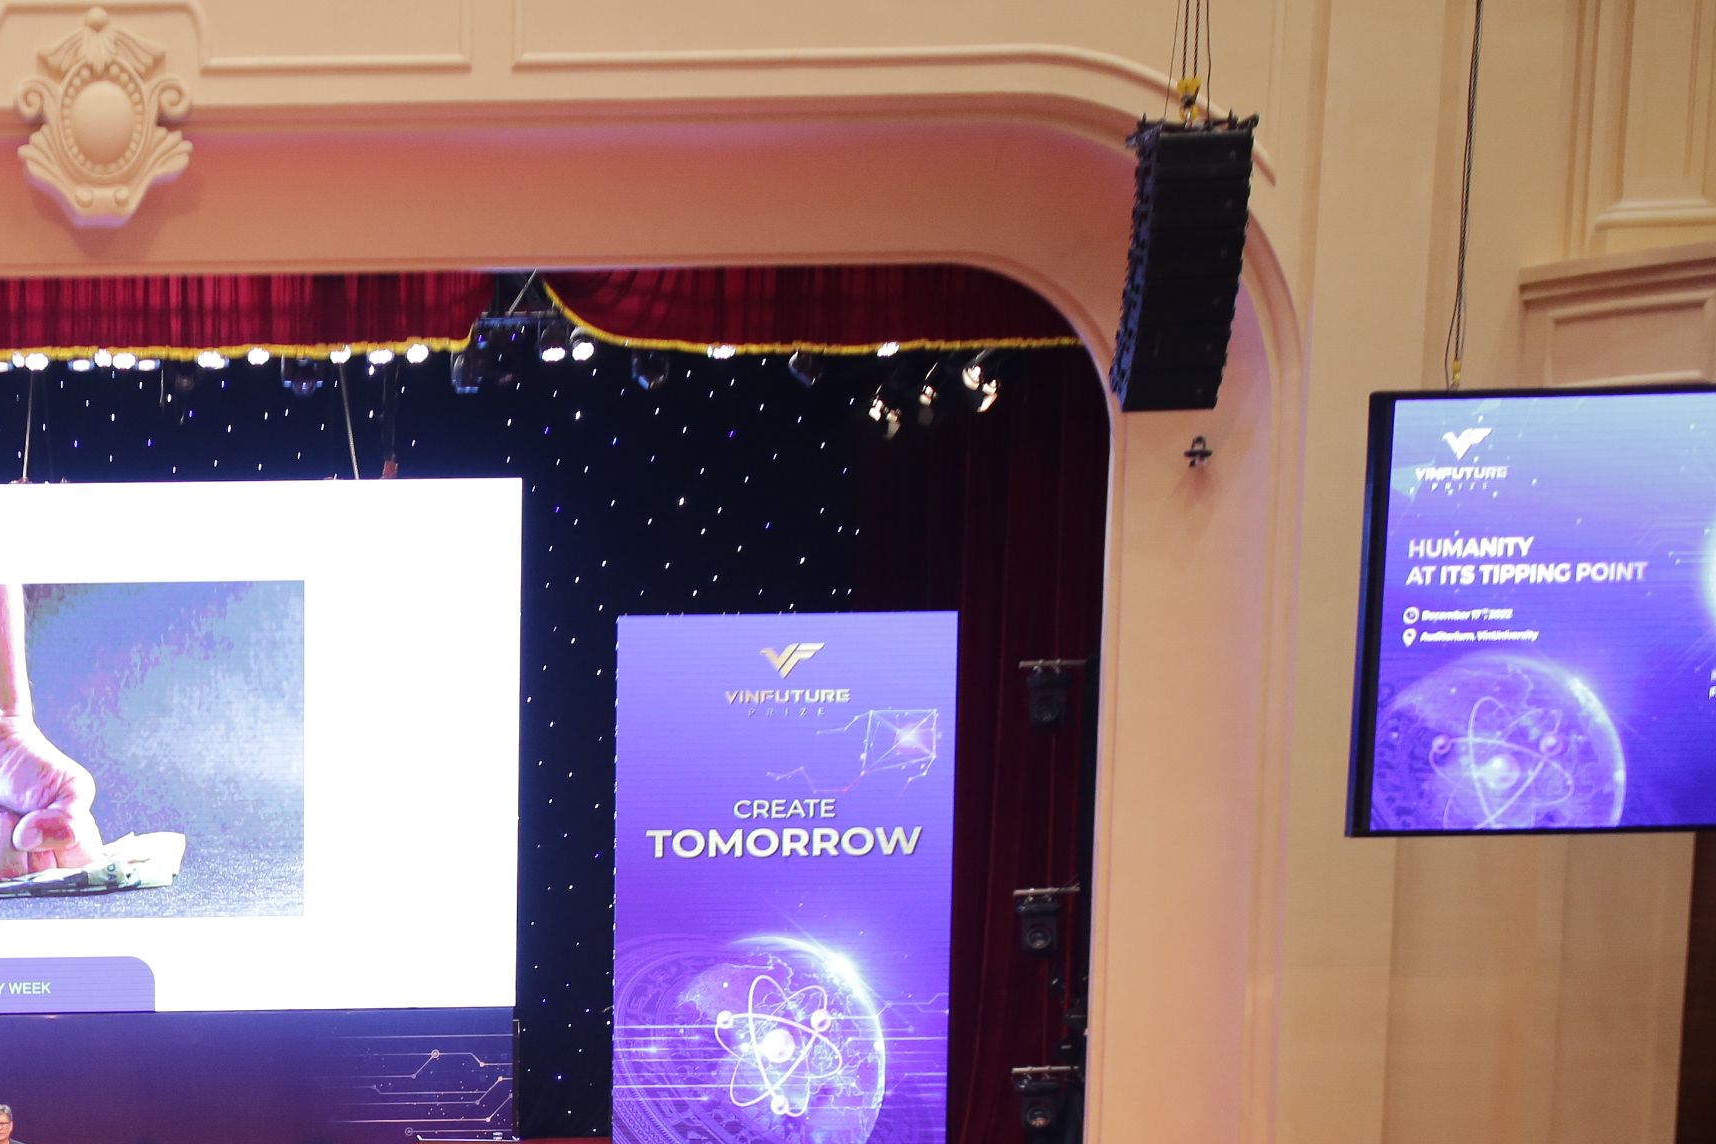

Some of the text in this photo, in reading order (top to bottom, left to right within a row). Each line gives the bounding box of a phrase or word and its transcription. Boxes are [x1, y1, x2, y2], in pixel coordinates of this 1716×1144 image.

[1415, 466, 1508, 481] VINFUTURE
[1407, 536, 1534, 558] HUMANITY
[1405, 561, 1648, 585] AT ITS TIPPING POINT
[726, 689, 851, 704] VINFUTURE
[748, 707, 826, 718] PRIZE
[734, 799, 836, 819] CREATE
[645, 826, 922, 859] TOMORROW
[8, 981, 51, 995] WEEK
